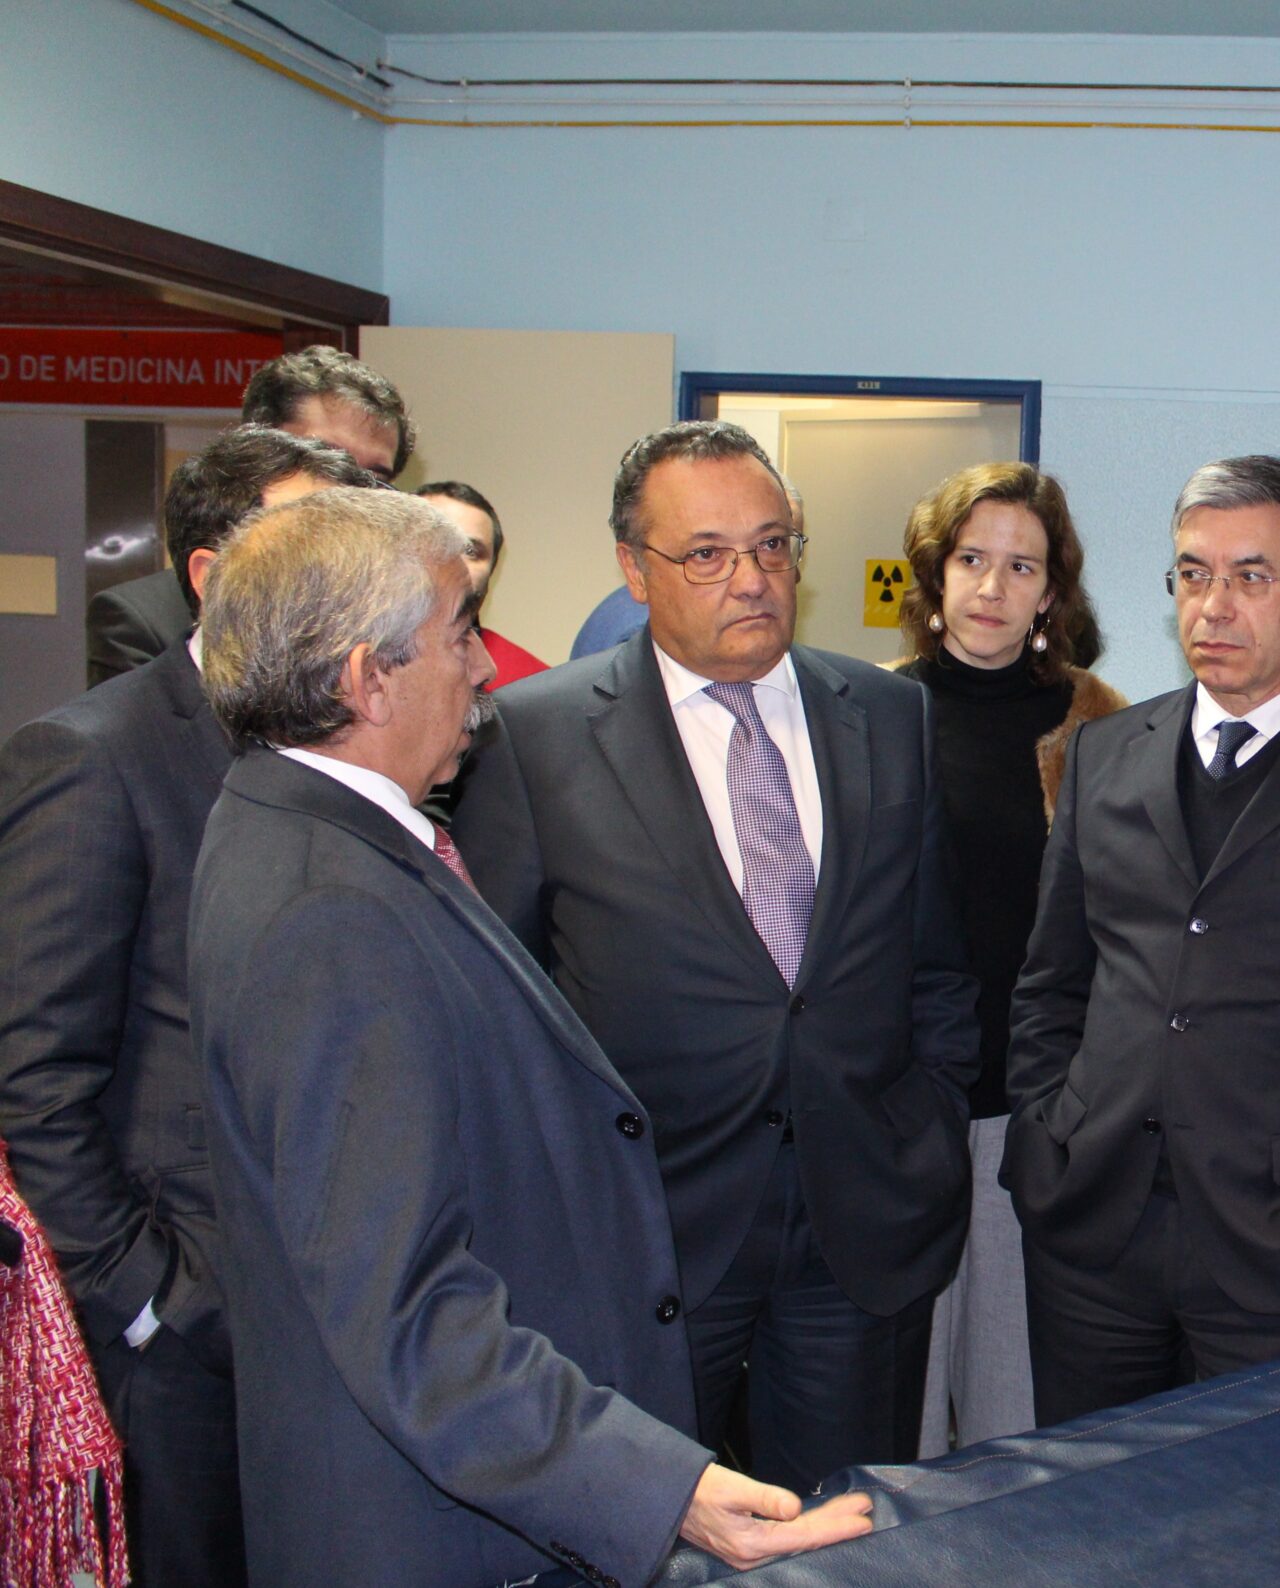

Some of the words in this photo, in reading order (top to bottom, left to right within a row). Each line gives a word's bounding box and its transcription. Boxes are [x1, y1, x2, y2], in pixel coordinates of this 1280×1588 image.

[19, 355, 56, 381] DE
[65, 356, 205, 384] MEDICINA
[214, 358, 274, 384] INT
